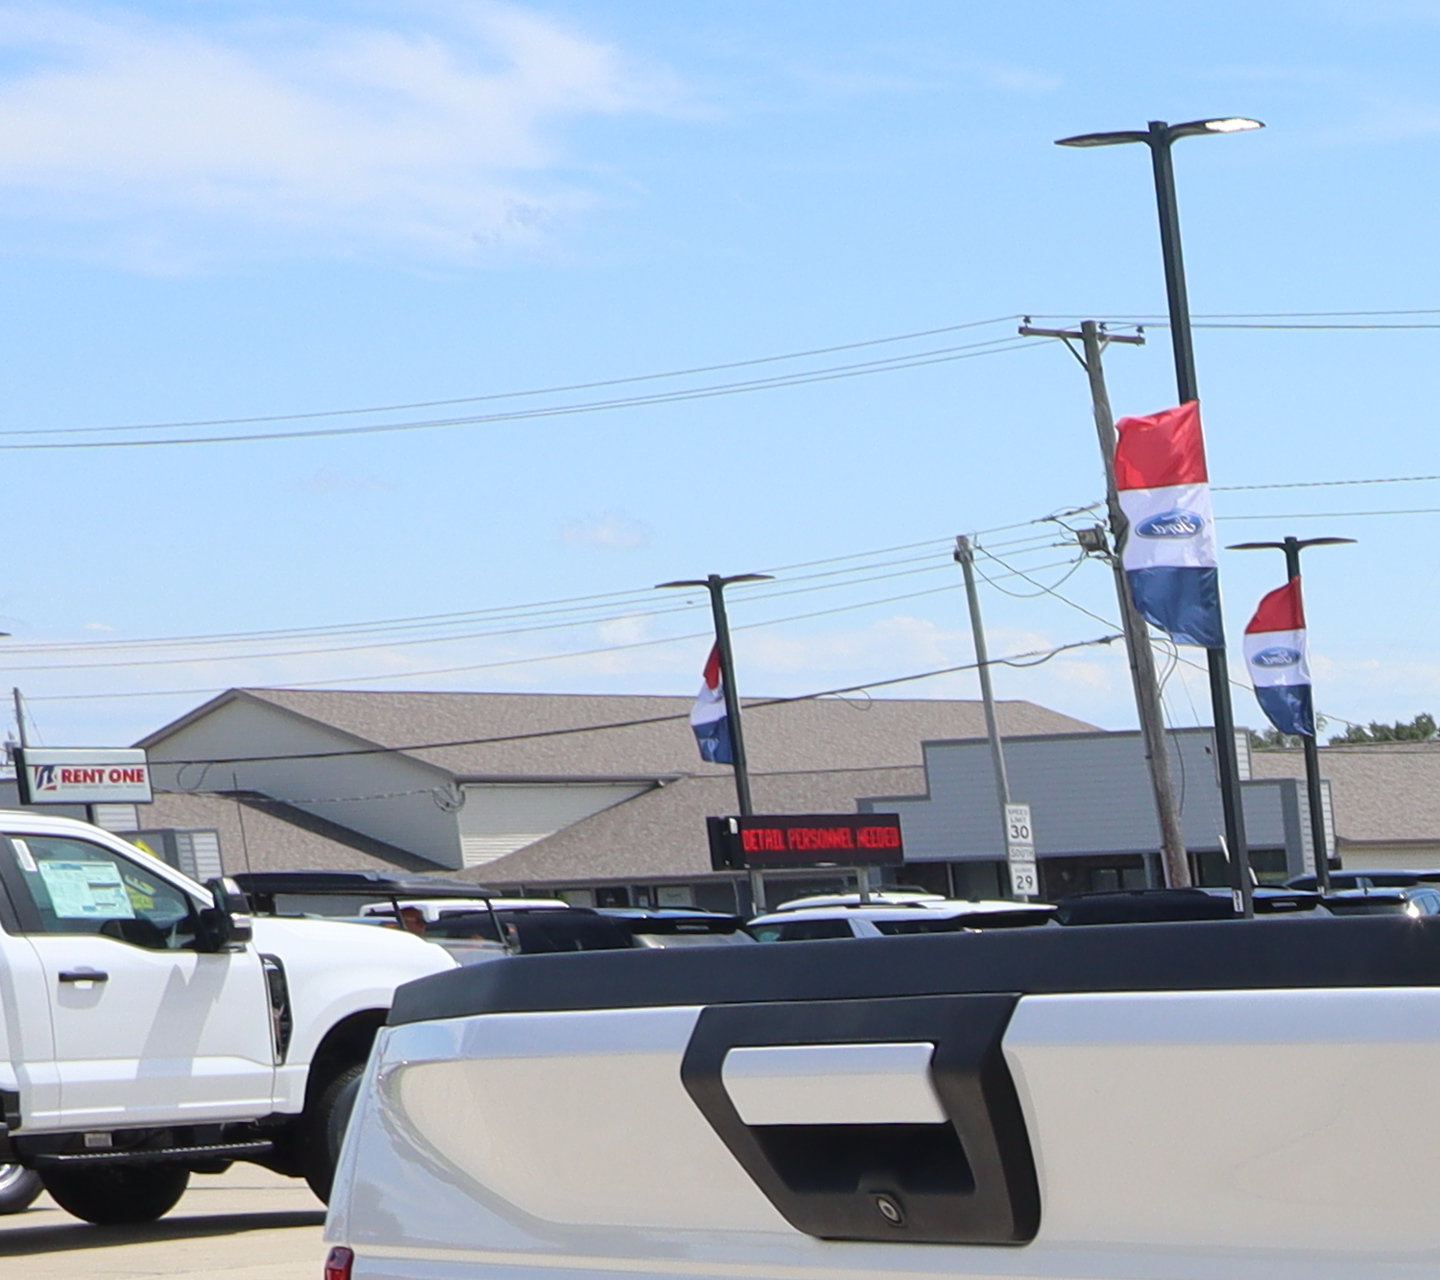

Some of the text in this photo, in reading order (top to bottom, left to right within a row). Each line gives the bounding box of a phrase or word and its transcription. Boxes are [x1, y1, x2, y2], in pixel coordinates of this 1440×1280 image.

[61, 768, 144, 783] RENT ONE
[741, 826, 900, 852] DETAIL PERSONNEL NEEDED
[1010, 825, 1029, 839] 30
[1011, 848, 1034, 858] SOUTH
[1016, 876, 1033, 890] 29
